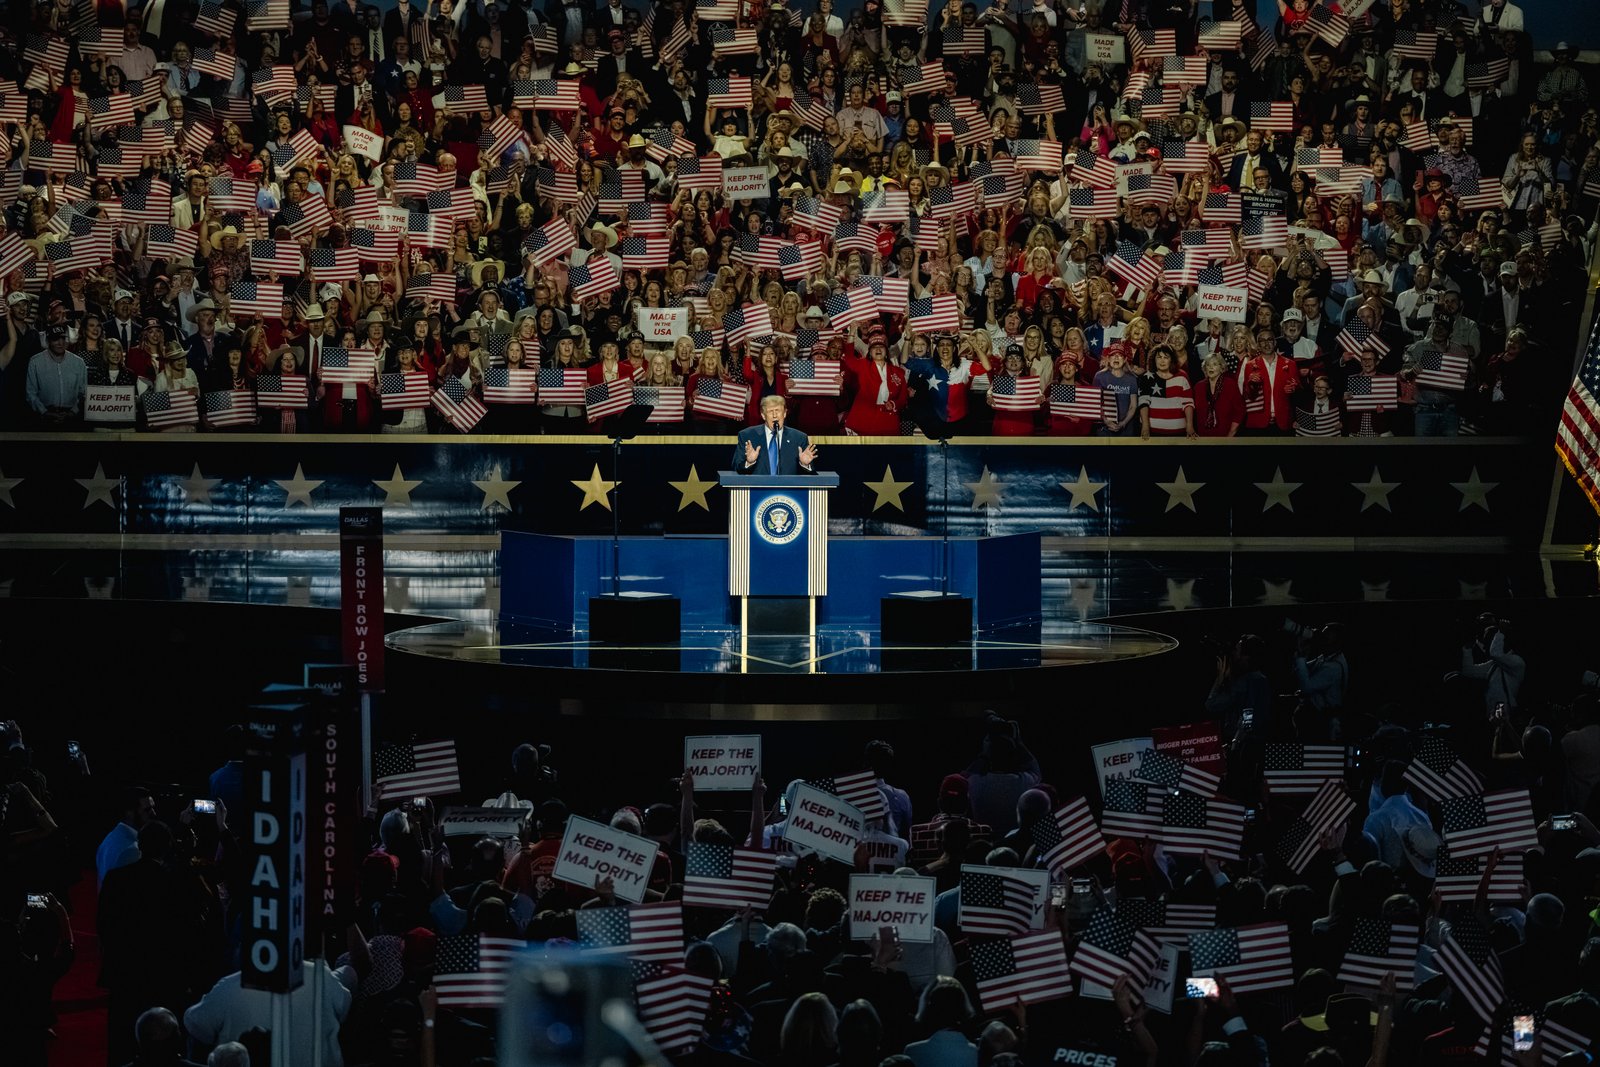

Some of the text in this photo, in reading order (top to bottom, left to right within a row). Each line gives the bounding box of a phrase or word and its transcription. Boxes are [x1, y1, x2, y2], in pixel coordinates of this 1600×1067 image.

[352, 130, 374, 142] MADE
[352, 142, 368, 151] USA
[1123, 168, 1143, 176] MADE
[727, 183, 766, 192] MAJORITY
[392, 215, 406, 223] THE
[1203, 292, 1243, 303] KEEP THE
[1200, 303, 1243, 313] MAJORITY
[650, 313, 676, 321] MADE
[355, 545, 368, 684] FRONT ROW JOES
[1181, 735, 1218, 747] PAYCHECKS
[691, 748, 755, 760] KEEP THE
[1181, 748, 1195, 756] FOR
[1103, 753, 1135, 768] KEEP
[1190, 753, 1221, 764] FAMILIES
[689, 765, 757, 776] MAJORITY
[322, 723, 338, 915] SOUTH CAROLINA
[800, 798, 861, 832] KEEP THE
[792, 816, 862, 850] MAJORITY
[573, 833, 648, 867] KEEP THE
[250, 769, 281, 974] IDAHO
[292, 768, 304, 971] IDAHO
[563, 850, 645, 886] MAJORITY
[855, 889, 927, 905] KEEP THE
[852, 910, 930, 925] MAJORITY
[1053, 1047, 1118, 1067] PRICES
